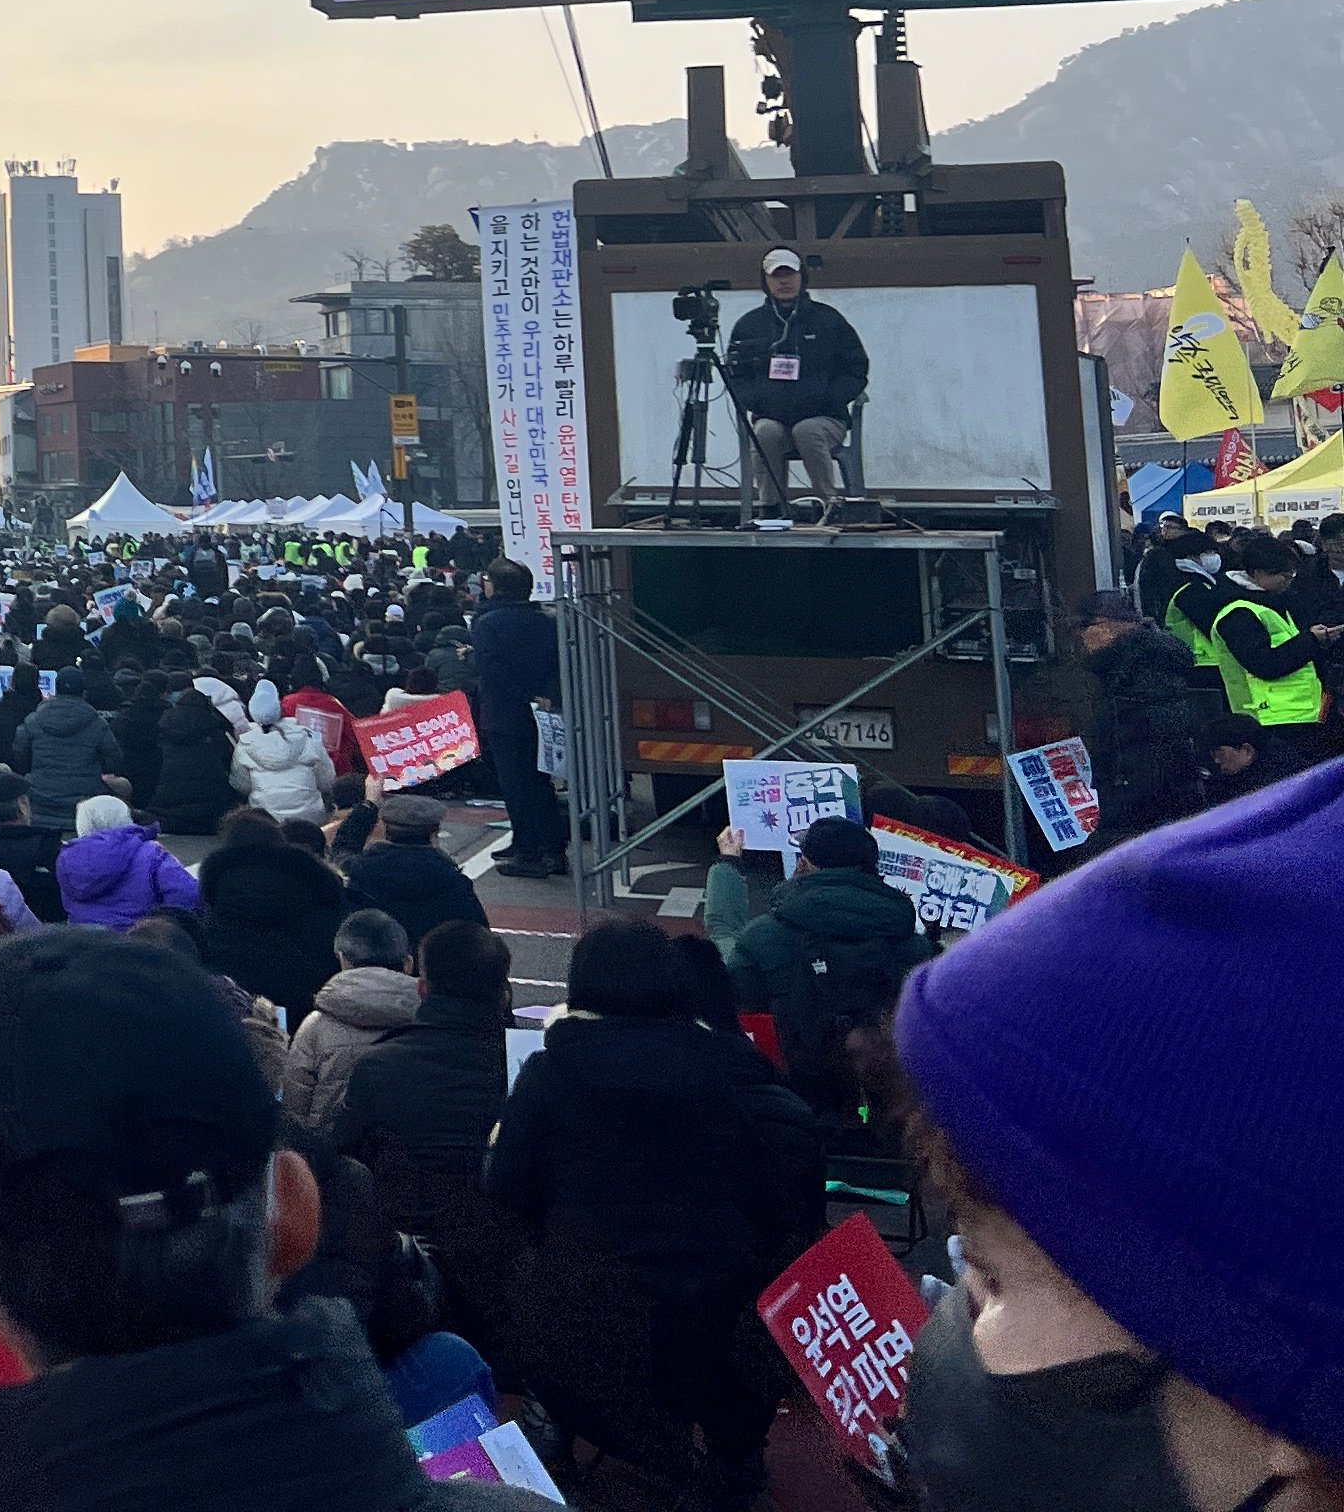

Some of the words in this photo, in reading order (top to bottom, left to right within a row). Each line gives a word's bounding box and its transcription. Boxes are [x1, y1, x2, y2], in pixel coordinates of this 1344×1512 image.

[490, 215, 510, 235] 을
[520, 212, 540, 252] 하는
[490, 239, 510, 297] 지키고
[520, 257, 540, 315] 것만이
[552, 209, 573, 328] 헌법재판소는
[492, 303, 514, 402] 민주주의가
[522, 320, 544, 400] 우리나라
[553, 334, 575, 374] 하루
[555, 379, 576, 419] 빨리
[526, 406, 549, 487] 대한민국
[557, 425, 577, 487] 윤석열
[791, 1273, 877, 1378] 윤석열
